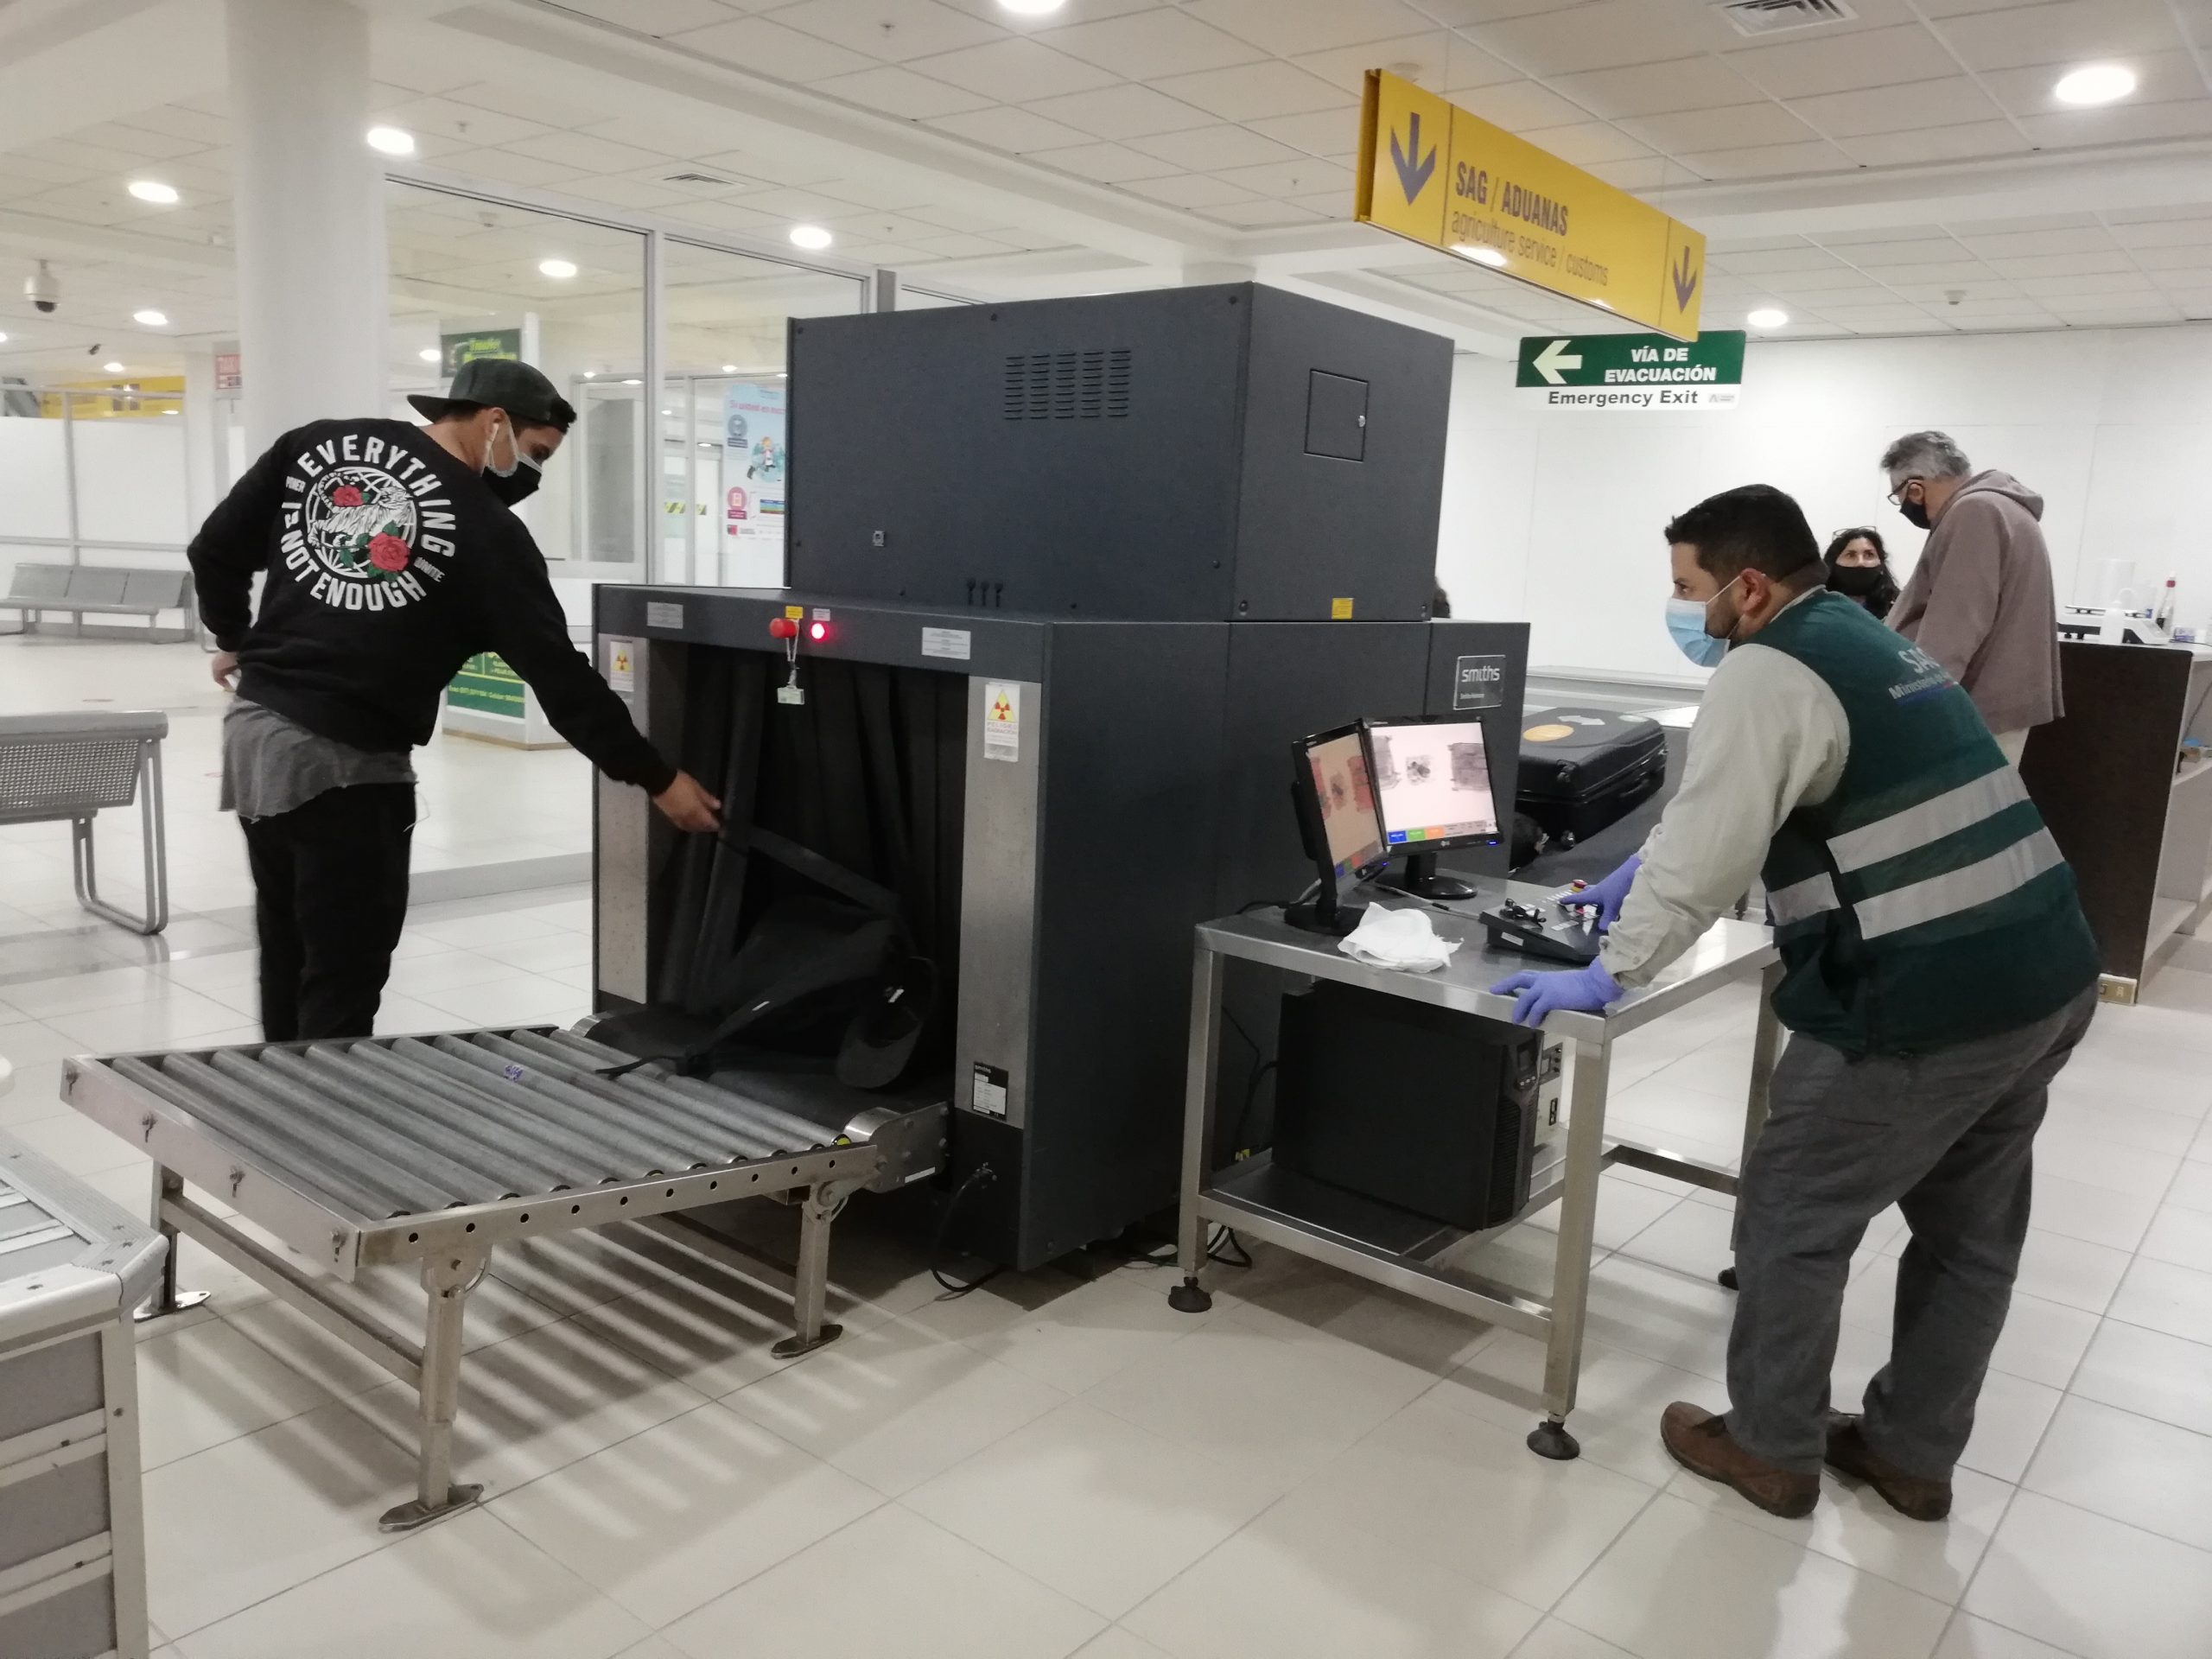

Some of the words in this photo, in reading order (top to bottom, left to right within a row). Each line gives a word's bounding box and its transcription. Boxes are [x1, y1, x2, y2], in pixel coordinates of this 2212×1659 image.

[1456, 161, 1488, 205] SAG
[1501, 181, 1568, 237] ADUANAS
[1452, 210, 1515, 252] agriculture
[1518, 235, 1556, 268] service
[1566, 253, 1609, 286] customs
[1605, 365, 1717, 383] EVACUACIÓN
[1630, 345, 1658, 363] VÍA
[1663, 347, 1689, 362] DE
[1548, 391, 1654, 407] Emergency
[1659, 390, 1699, 404] Exit
[297, 434, 456, 557] EVERYTHING
[280, 529, 321, 582] NOT
[309, 570, 427, 612] ENOUGH
